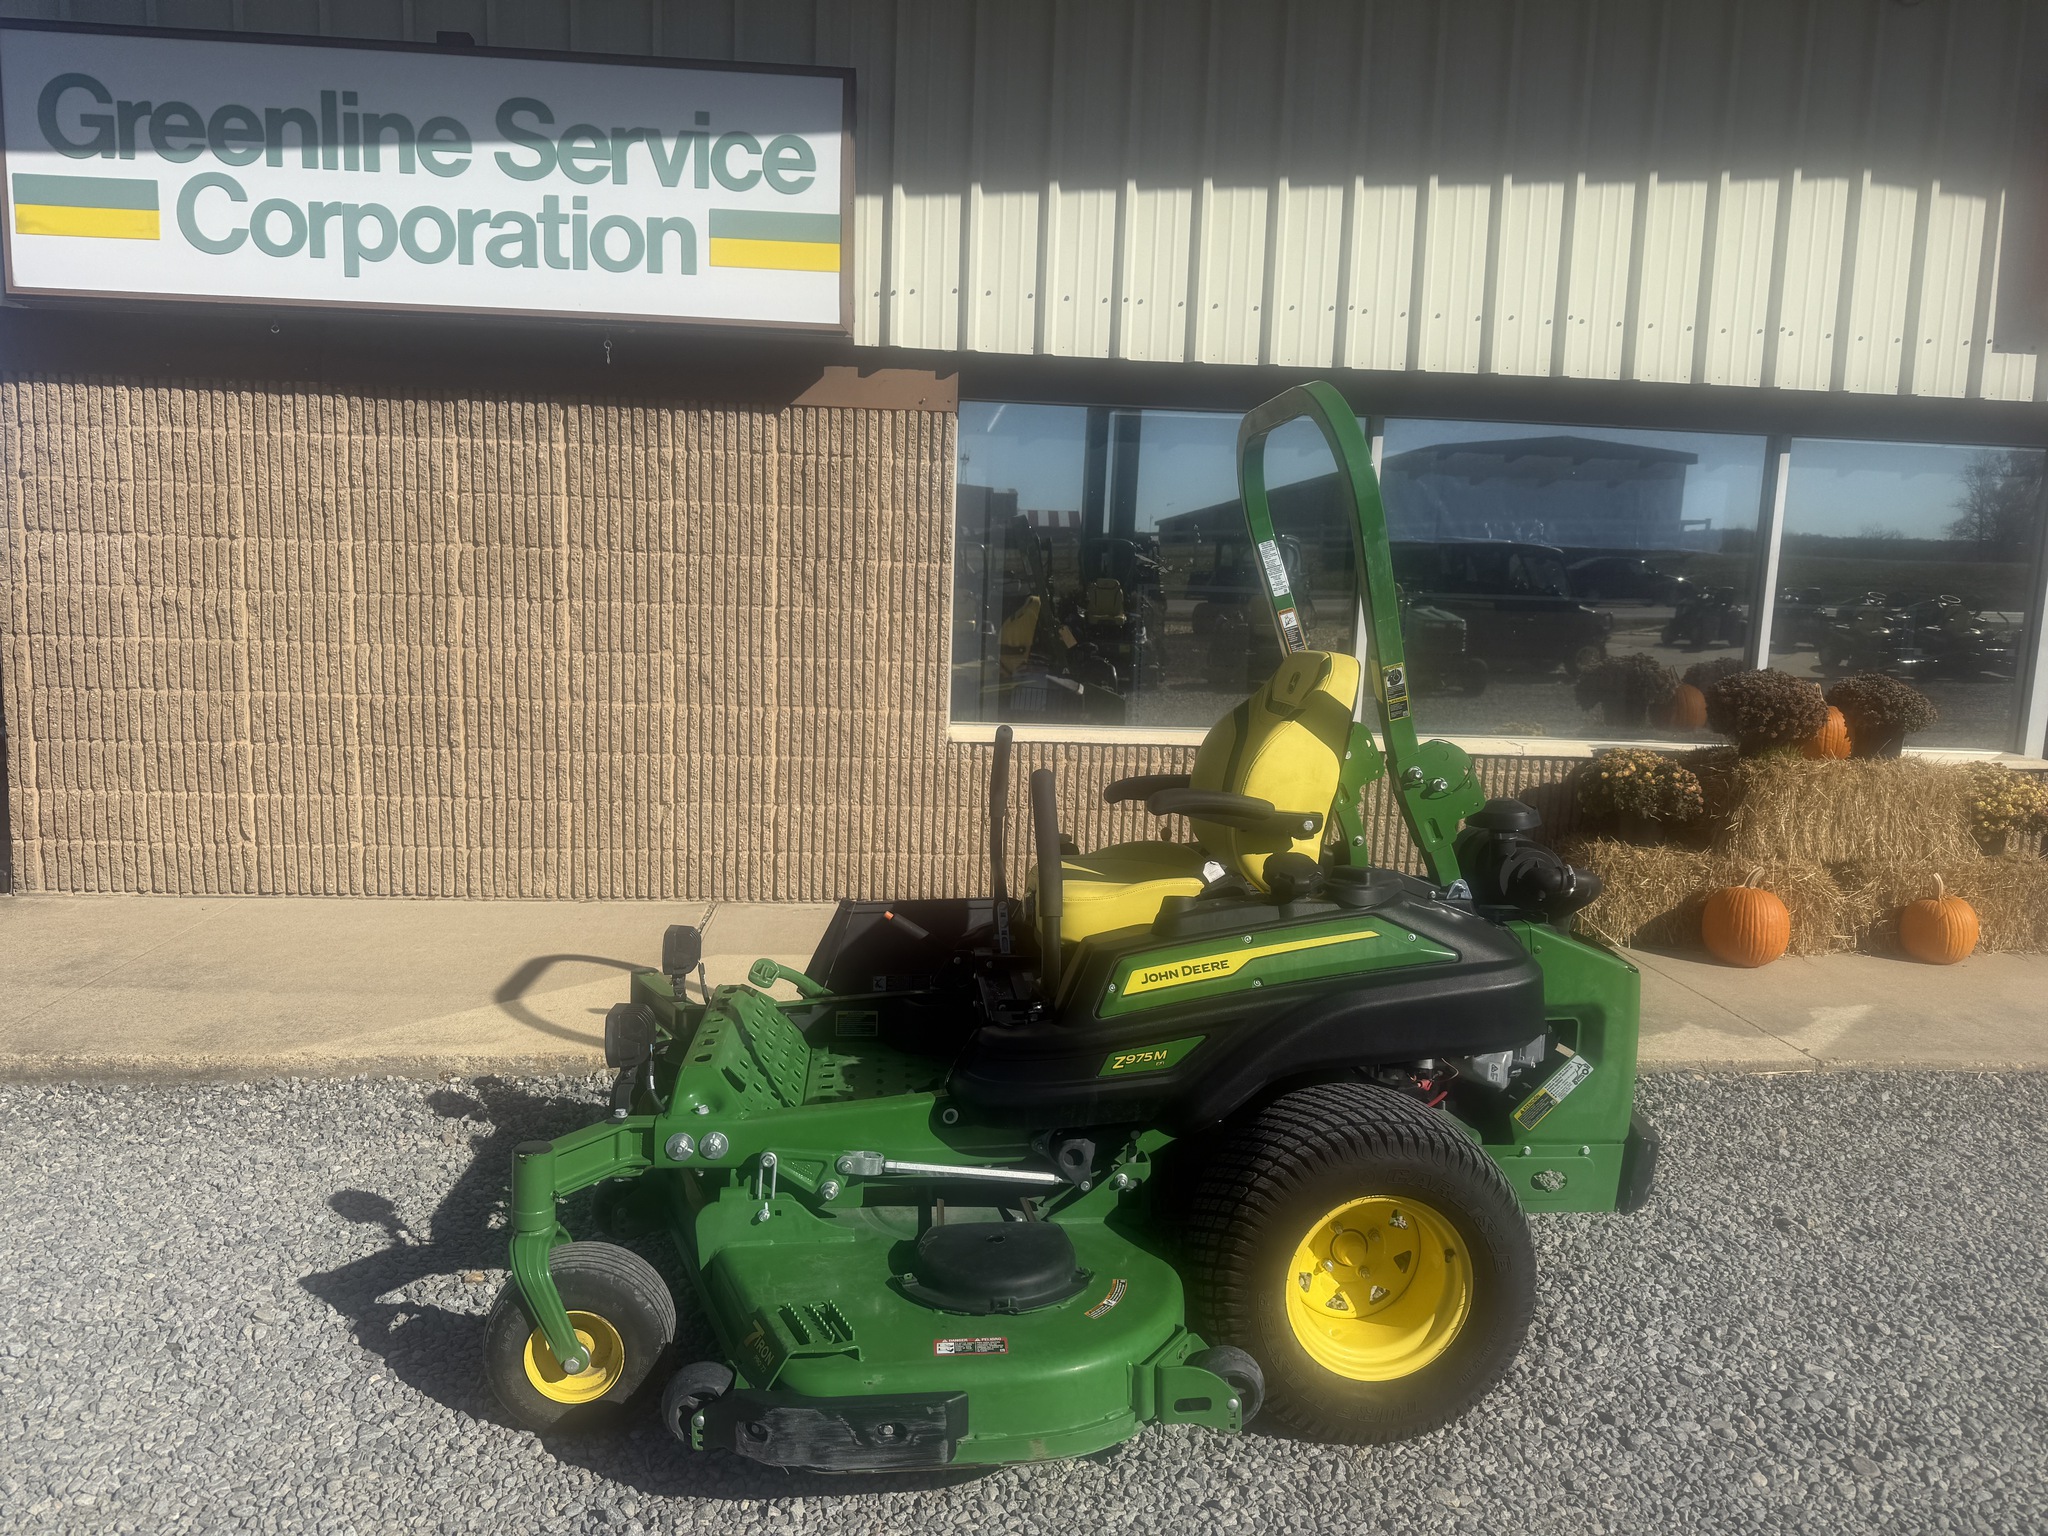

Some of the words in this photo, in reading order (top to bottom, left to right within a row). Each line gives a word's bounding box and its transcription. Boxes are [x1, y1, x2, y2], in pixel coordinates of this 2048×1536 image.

[37, 72, 472, 178] Greenline
[494, 97, 816, 195] Service
[176, 171, 697, 278] Corporation
[1141, 968, 1179, 985] JOHN
[1181, 959, 1230, 977] DEERE
